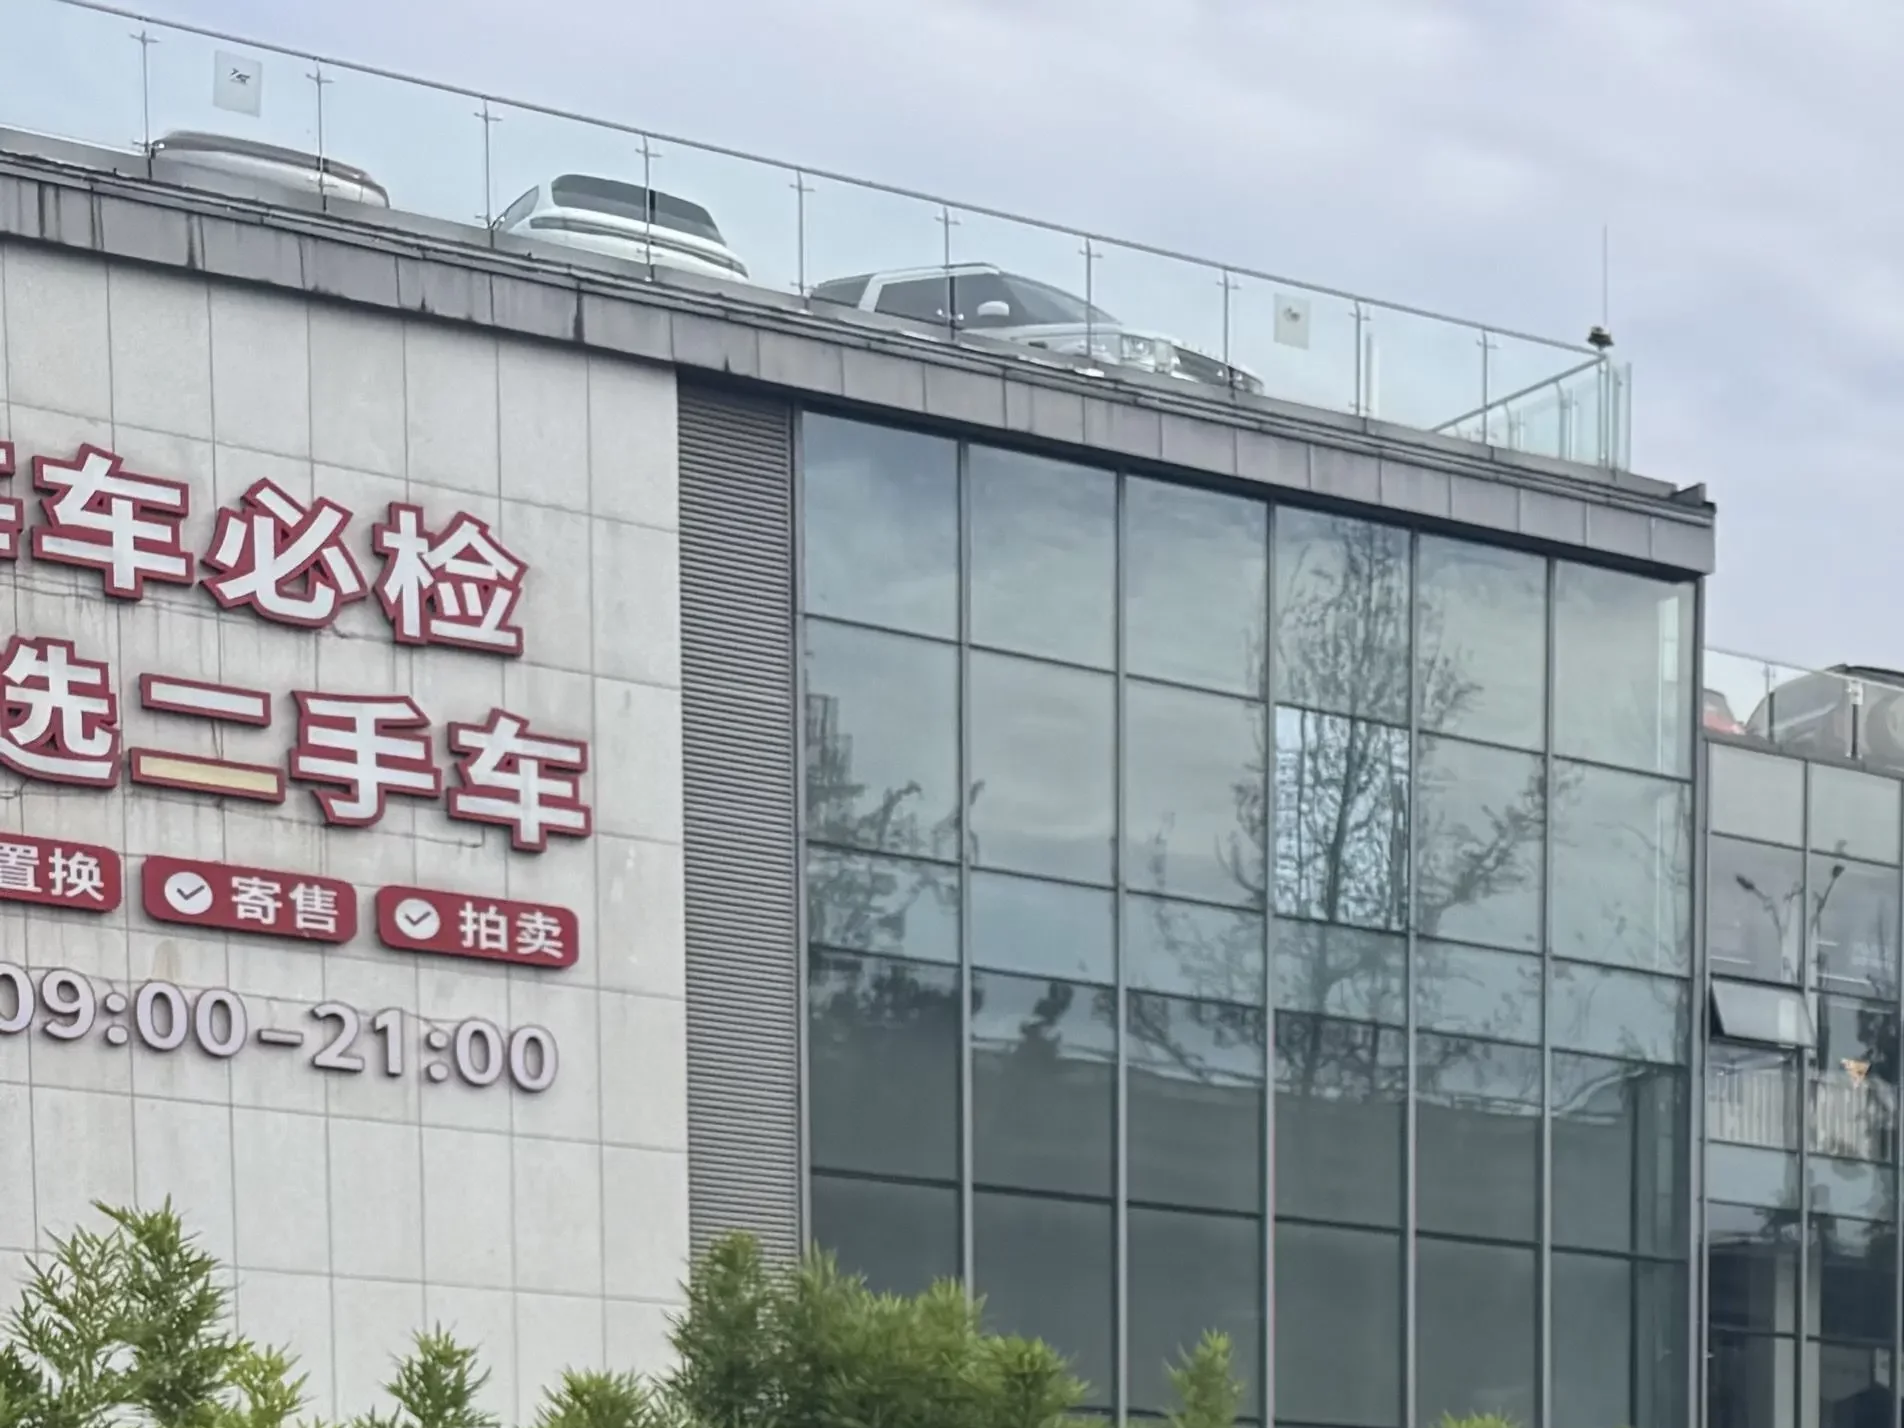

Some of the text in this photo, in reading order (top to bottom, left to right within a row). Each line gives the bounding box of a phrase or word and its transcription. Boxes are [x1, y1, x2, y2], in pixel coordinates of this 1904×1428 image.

[0, 440, 528, 656] 车必检
[0, 635, 592, 853] 选二手车
[0, 843, 565, 959] 置换 寄售 拍卖
[0, 960, 559, 1094] 09:00-21:00
